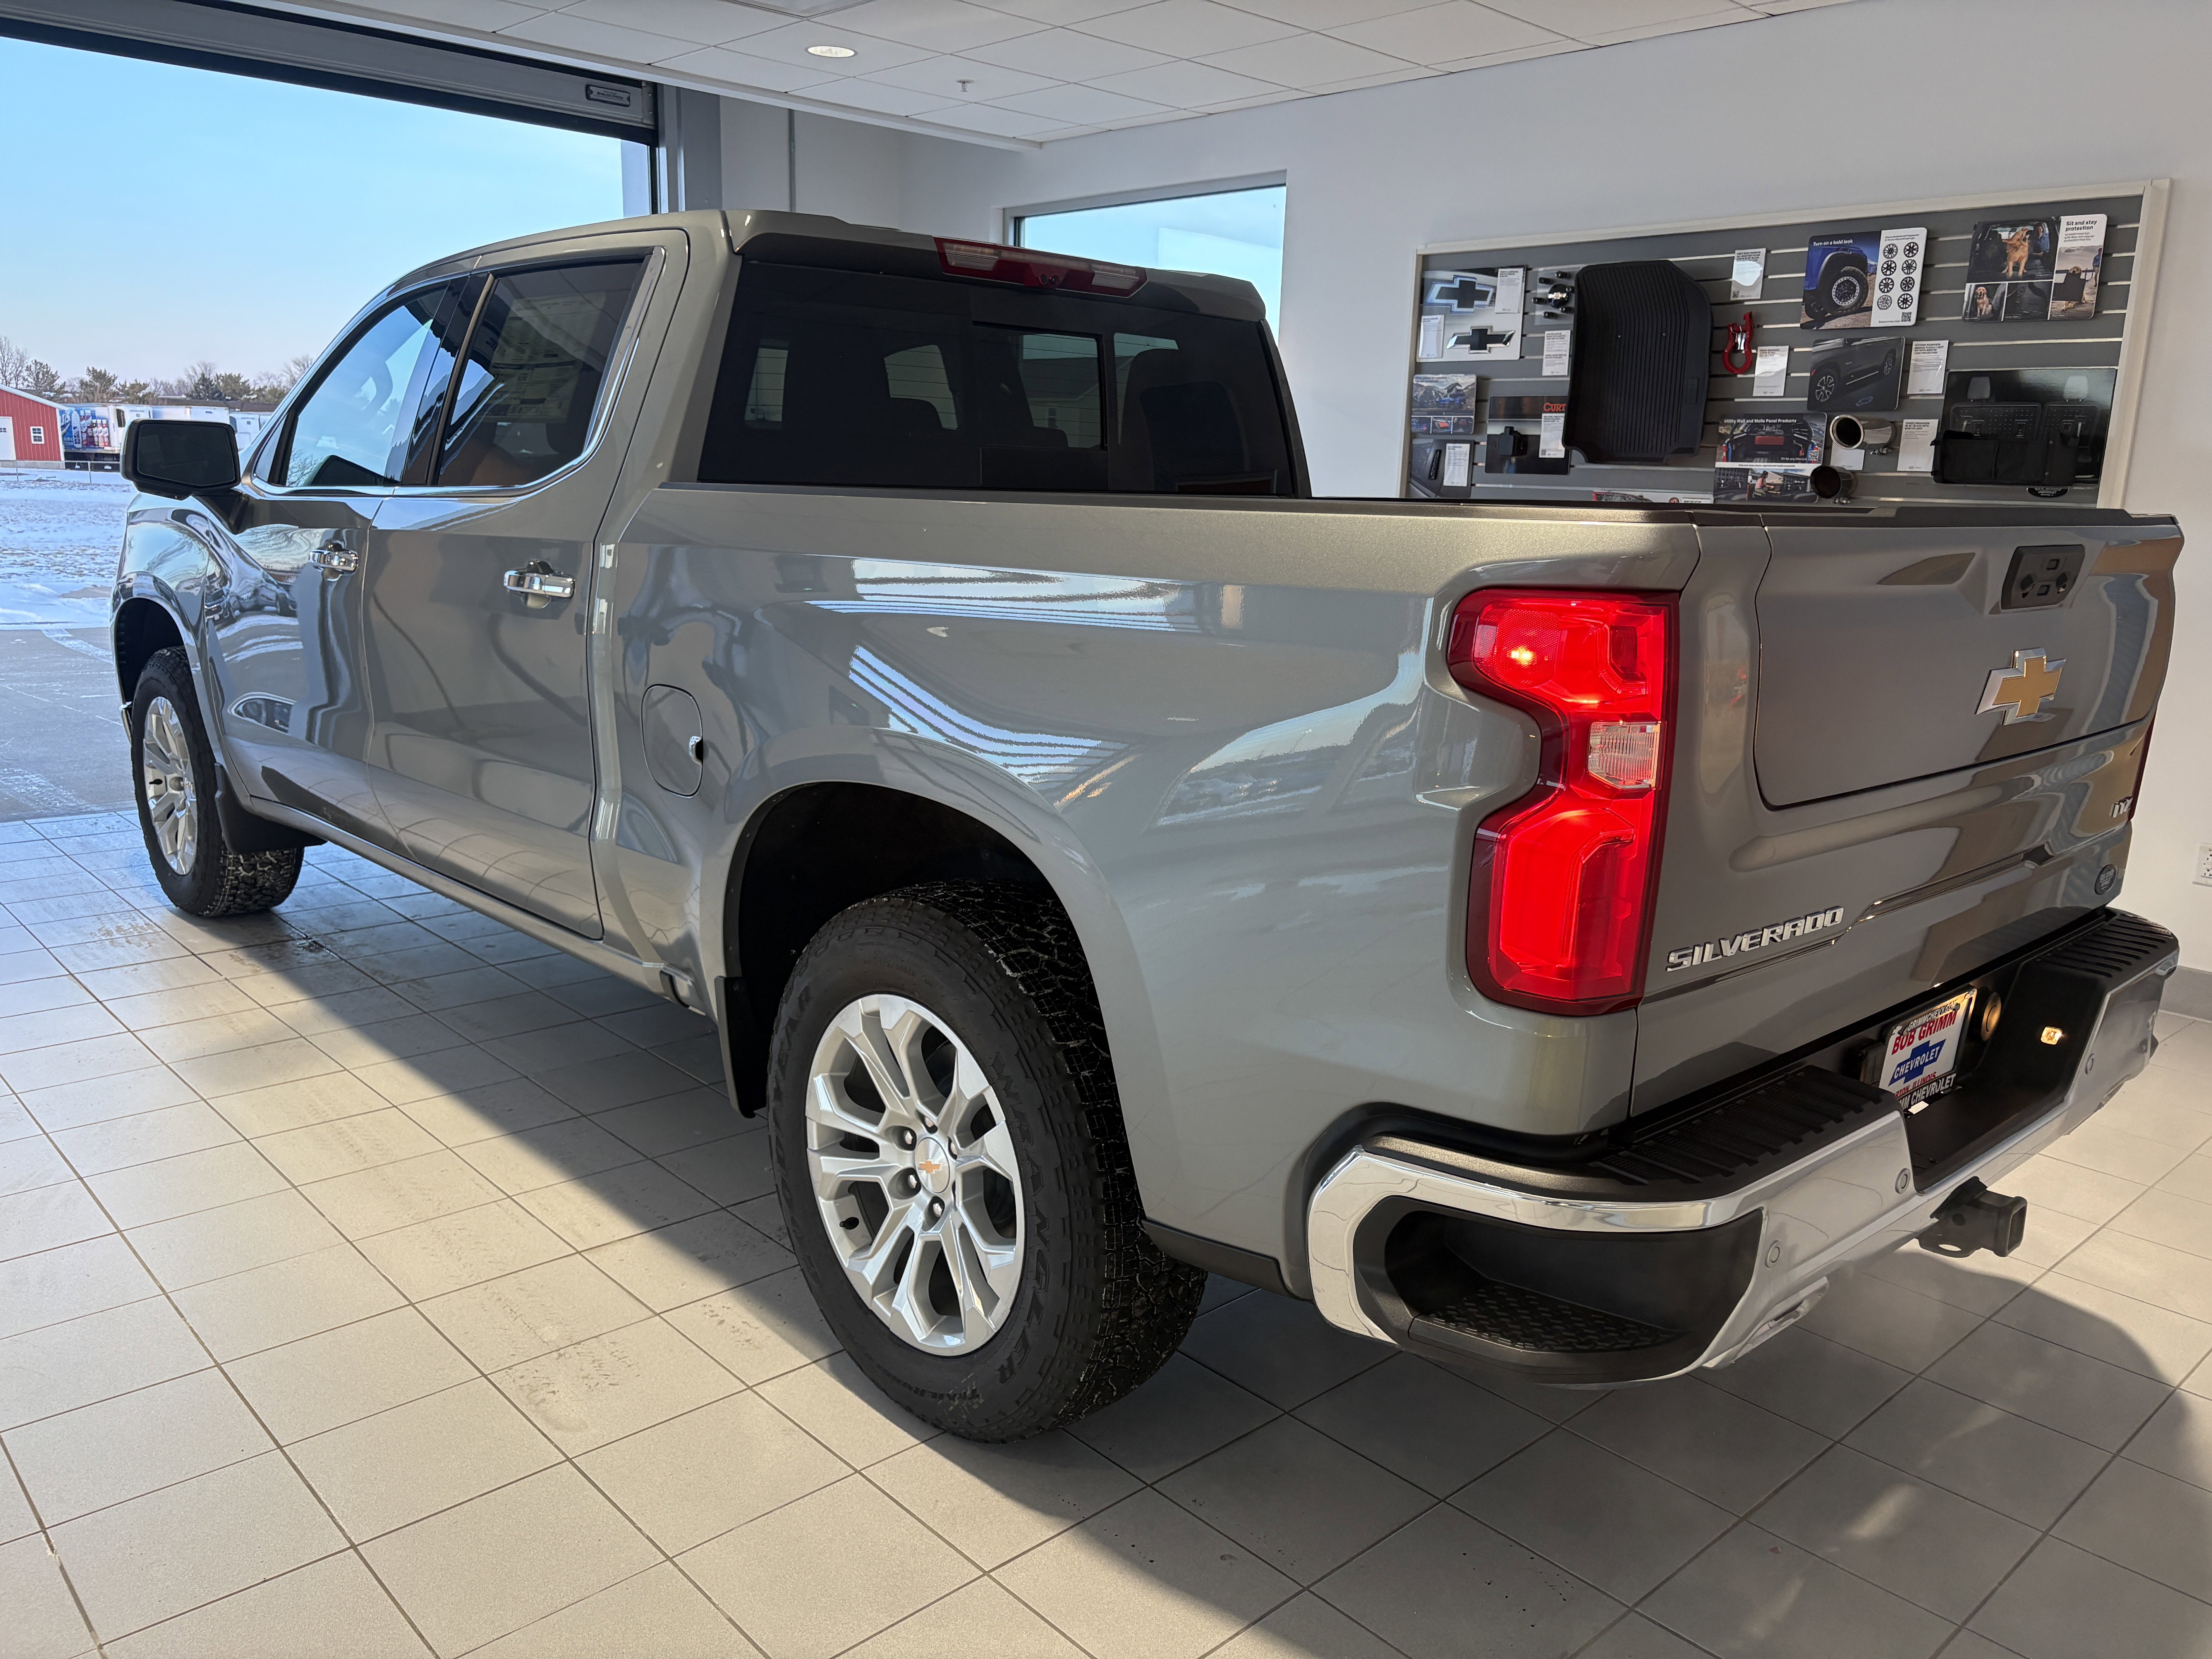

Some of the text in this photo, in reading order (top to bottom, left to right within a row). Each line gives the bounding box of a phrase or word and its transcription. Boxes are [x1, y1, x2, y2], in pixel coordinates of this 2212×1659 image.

[1666, 905, 1844, 972] SILVERADO
[1892, 1011, 1958, 1055] BOB GRIMM
[1894, 1046, 1940, 1079] CHEVROLET
[1911, 1073, 1956, 1105] CHEVROLET
[992, 1051, 1050, 1386] WRANGLER
